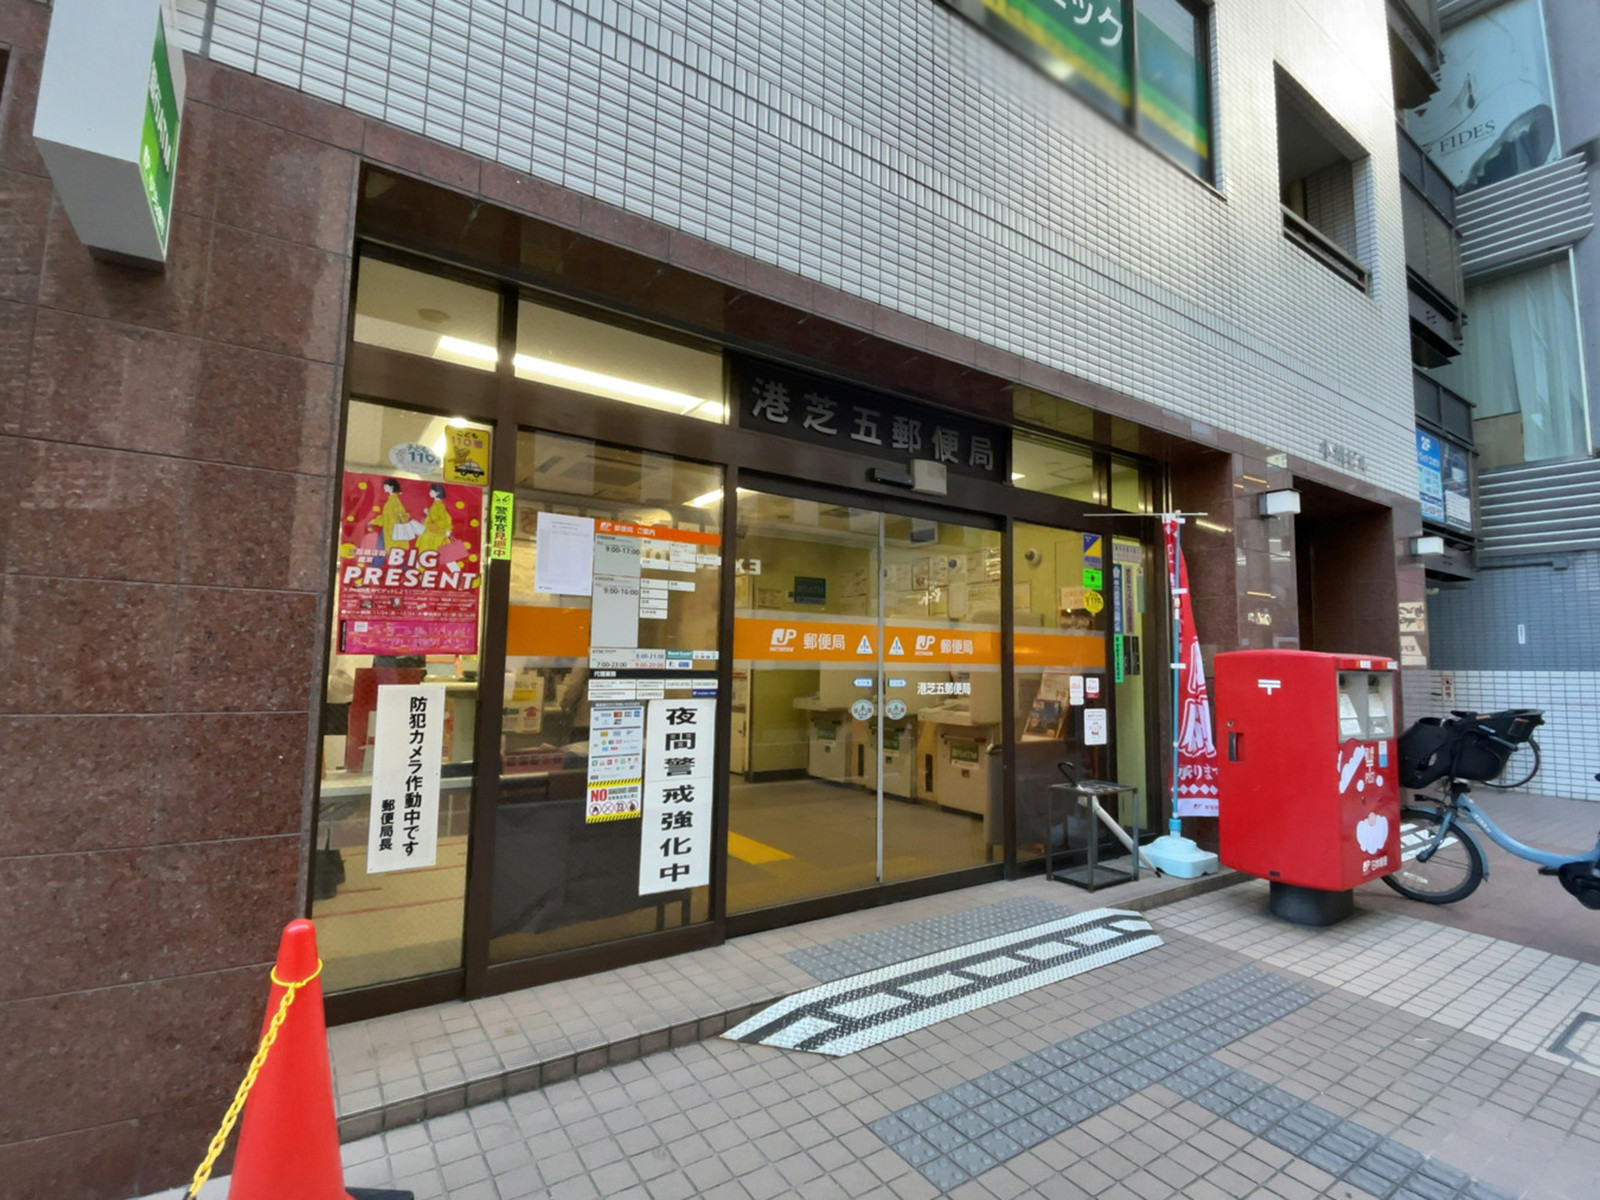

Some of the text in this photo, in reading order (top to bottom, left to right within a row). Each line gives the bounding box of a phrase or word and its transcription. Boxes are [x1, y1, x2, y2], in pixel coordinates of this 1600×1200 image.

[1055, 0, 1123, 46] ック
[1439, 119, 1496, 153] FIDES
[751, 376, 993, 472] 港芝五郵便局
[388, 547, 439, 568] BIG
[343, 566, 476, 590] PRESENT
[803, 632, 846, 651] 郵便局
[940, 638, 974, 655] 郵便局
[917, 682, 971, 696] 港芝五郵便局
[403, 696, 428, 857] 防犯カメラ作動中です
[591, 788, 608, 803] NO
[659, 706, 698, 883] 夜間警戒強化中
[379, 798, 396, 851] 郵便局長
